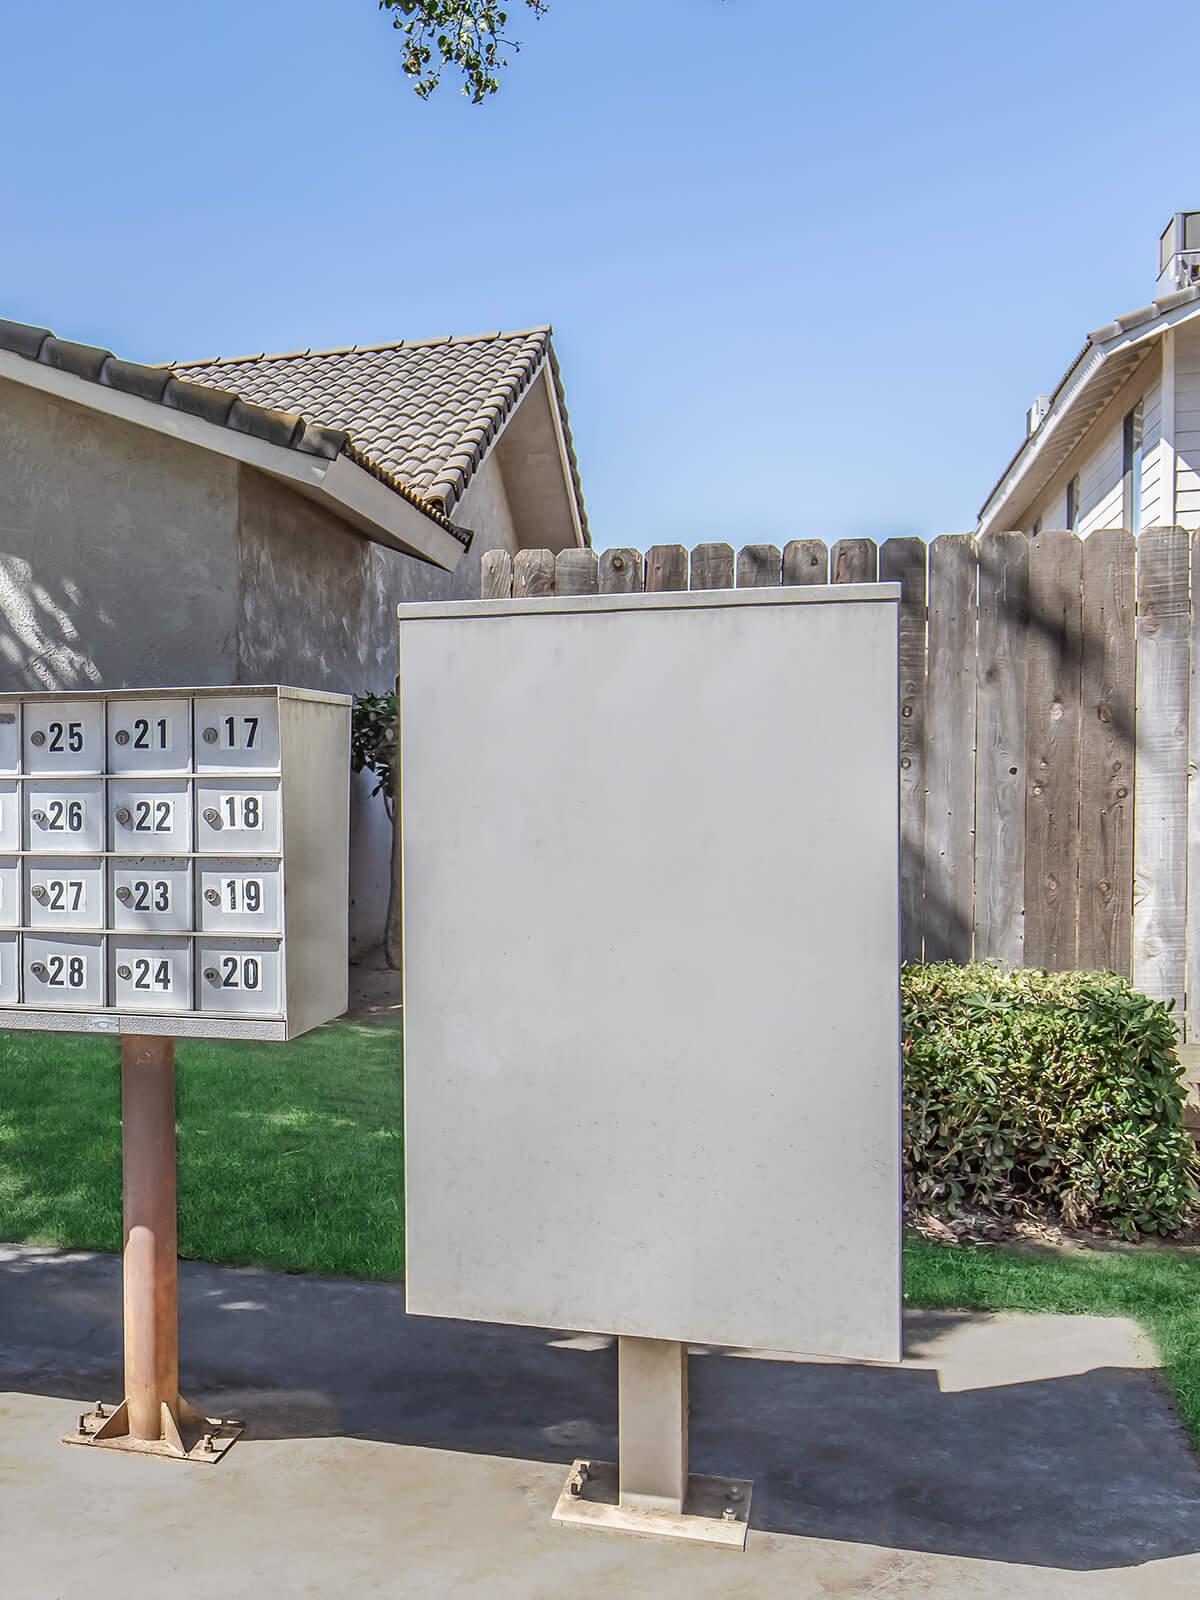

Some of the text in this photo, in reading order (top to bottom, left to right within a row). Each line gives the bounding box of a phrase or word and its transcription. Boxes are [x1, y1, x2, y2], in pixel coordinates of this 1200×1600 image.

[49, 723, 83, 752] 25
[134, 719, 167, 749] 21
[225, 718, 258, 748] 17
[49, 802, 82, 831] 26
[136, 801, 171, 831] 22
[225, 797, 258, 828] 18
[50, 881, 83, 910] 27
[135, 881, 169, 911] 23
[228, 881, 260, 911] 19
[49, 957, 83, 987] 28
[135, 960, 170, 989] 24
[223, 957, 258, 988] 20
